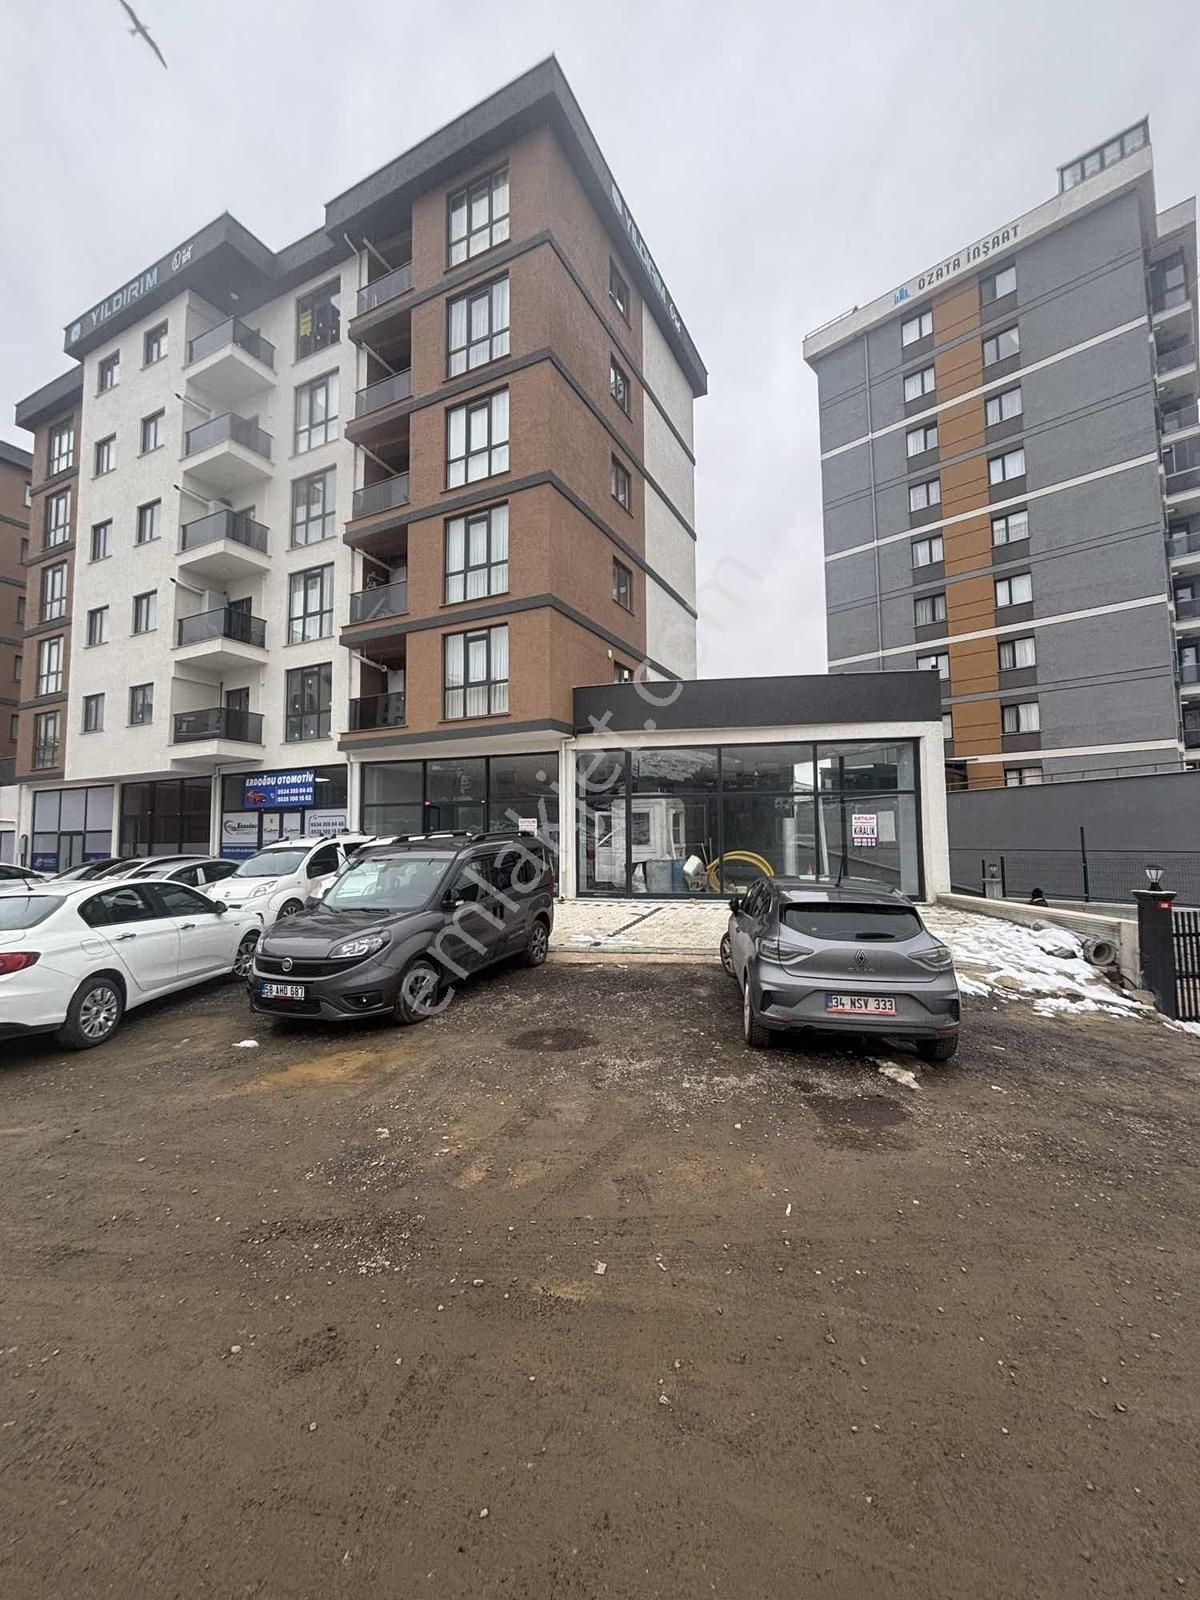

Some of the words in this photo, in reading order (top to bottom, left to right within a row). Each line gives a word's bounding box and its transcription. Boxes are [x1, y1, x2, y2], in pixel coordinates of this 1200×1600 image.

[91, 267, 158, 326] YILDIRIM
[277, 771, 314, 785] OTOMOTİV
[832, 996, 846, 1009] 34
[850, 997, 869, 1010] NSV
[874, 998, 894, 1011] 333
